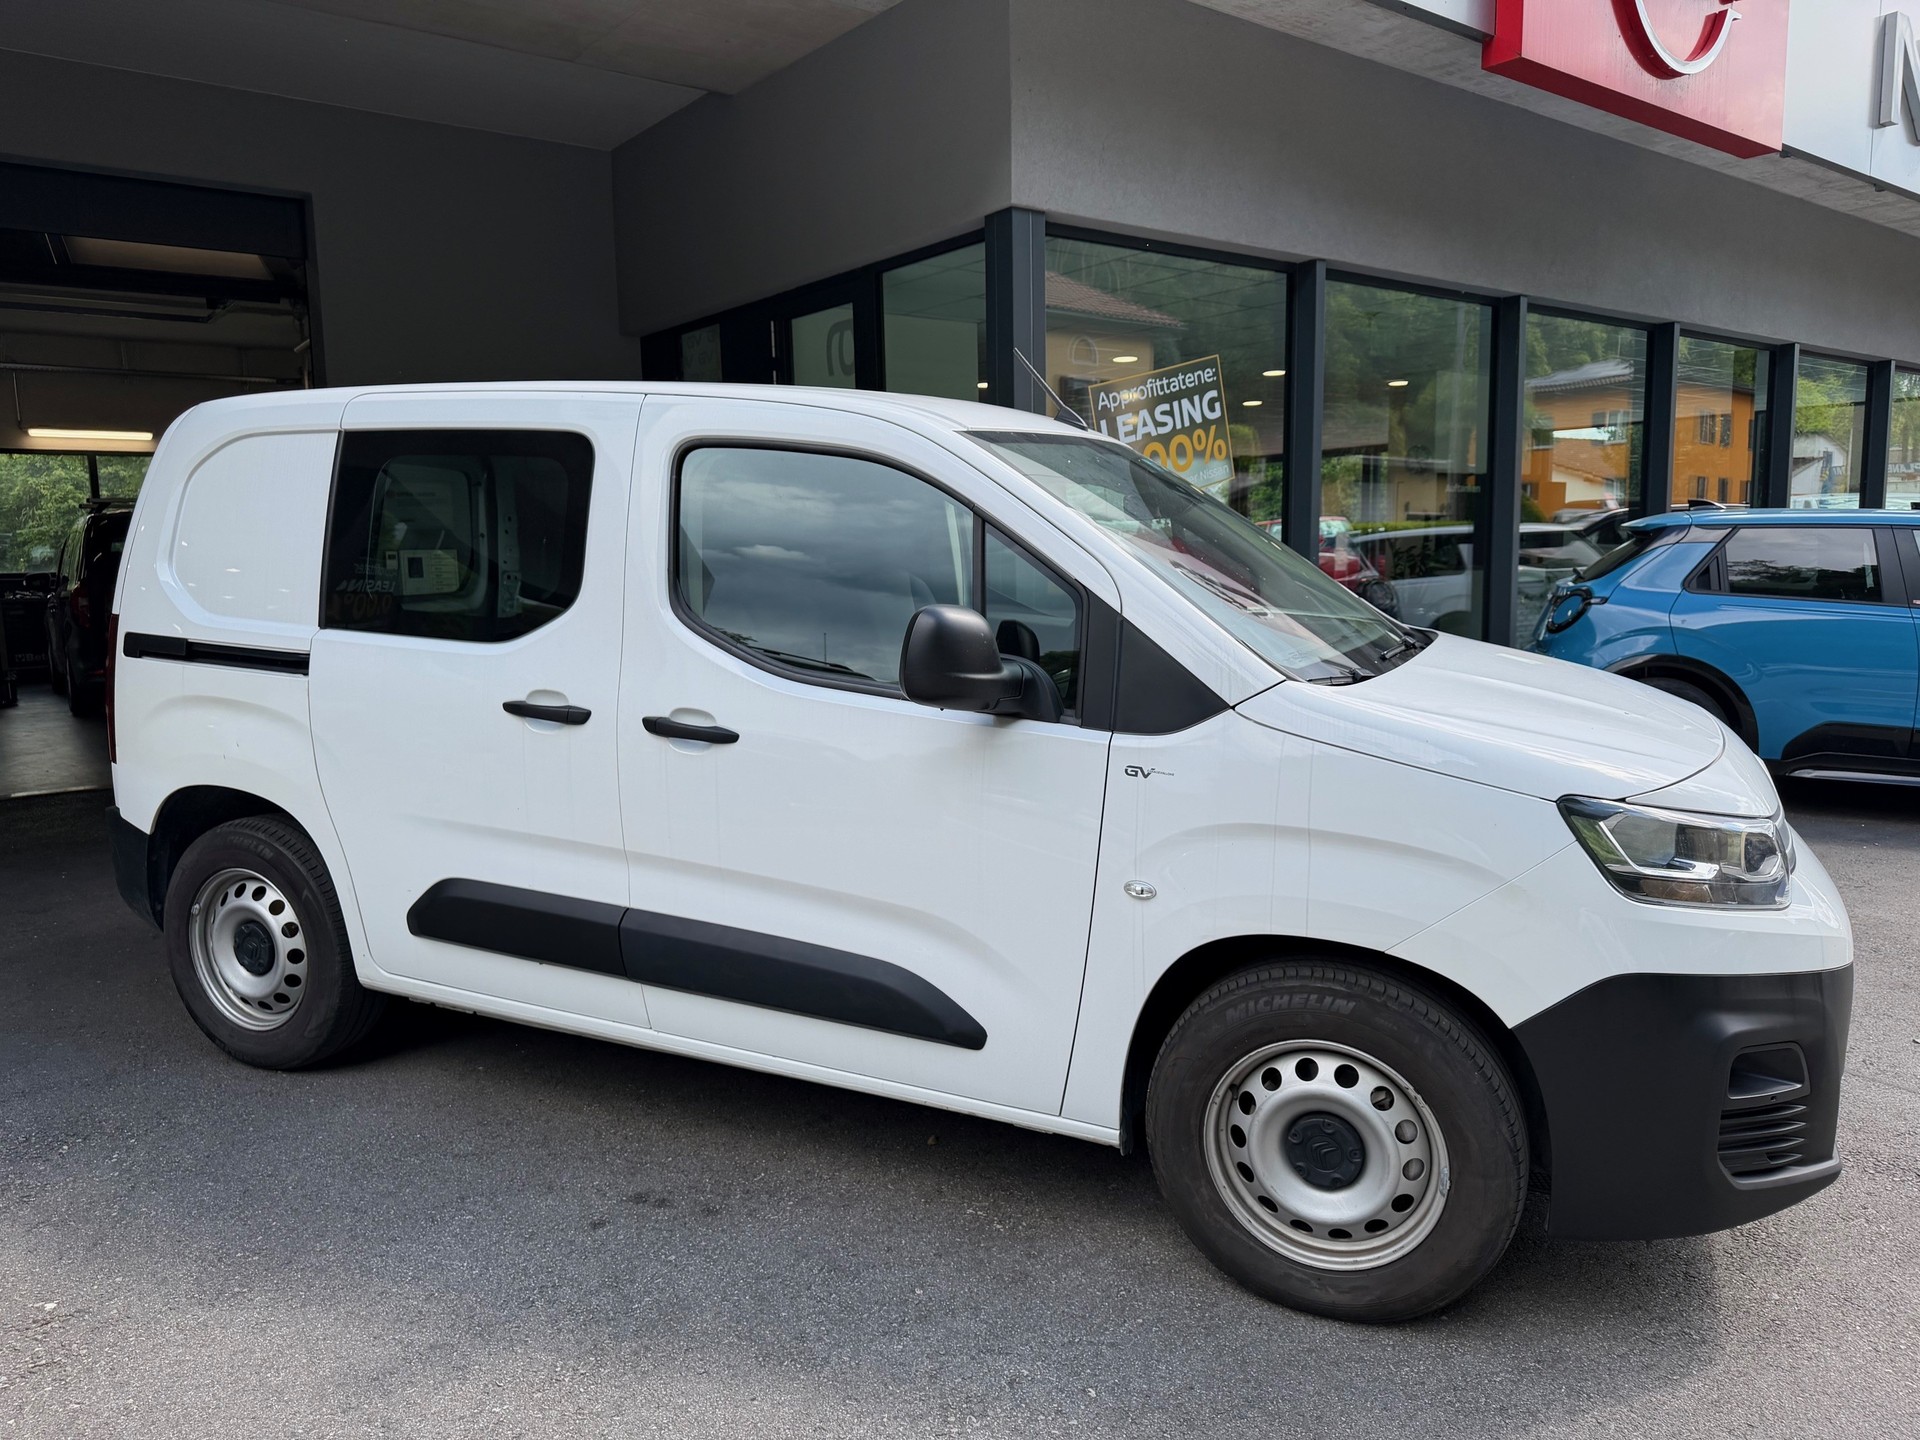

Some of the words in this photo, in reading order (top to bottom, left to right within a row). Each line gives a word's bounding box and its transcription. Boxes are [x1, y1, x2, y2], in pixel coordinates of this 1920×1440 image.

[1097, 367, 1217, 412] Approfittatene:
[1200, 465, 1229, 481] Nissan
[1225, 993, 1356, 1024] MICHELIN
